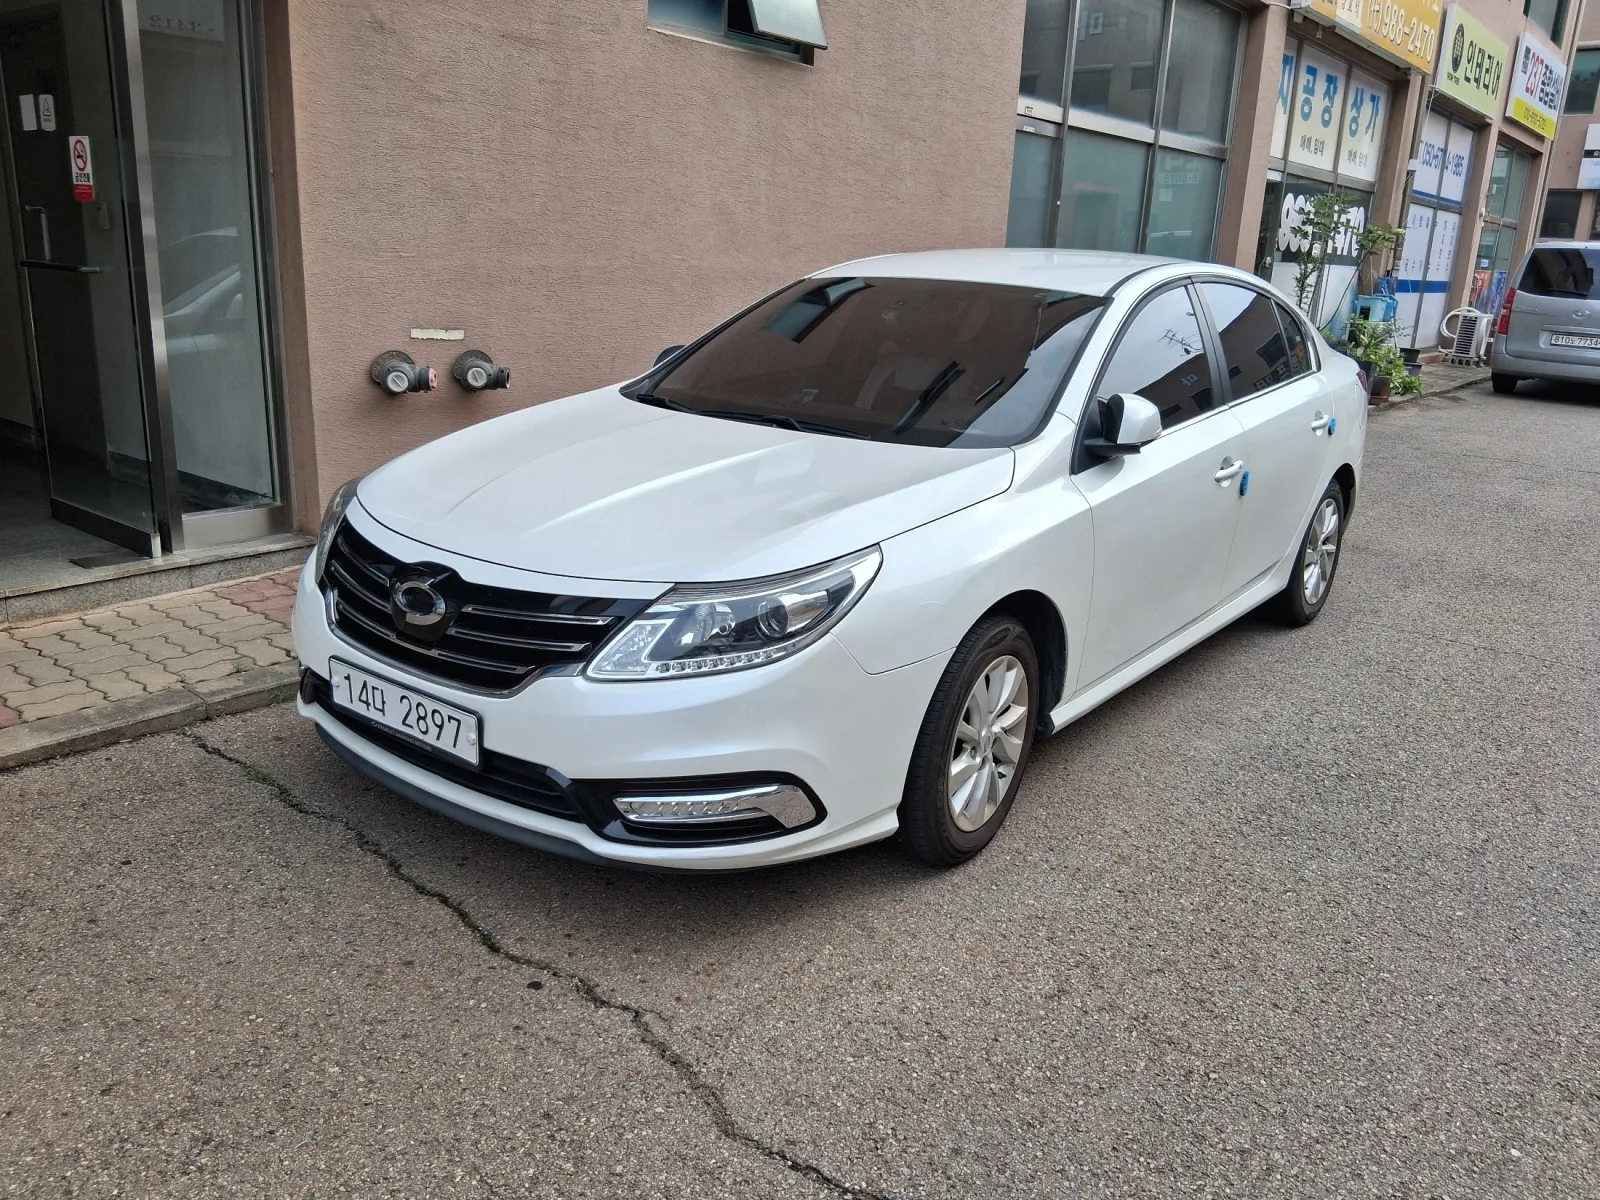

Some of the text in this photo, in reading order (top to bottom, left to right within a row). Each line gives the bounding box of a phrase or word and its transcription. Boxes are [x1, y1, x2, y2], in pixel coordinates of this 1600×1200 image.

[1301, 64, 1338, 129] 공장
[1348, 87, 1381, 143] 상가
[1464, 40, 1503, 100] 인테리어
[344, 673, 461, 748] 14다 2897
